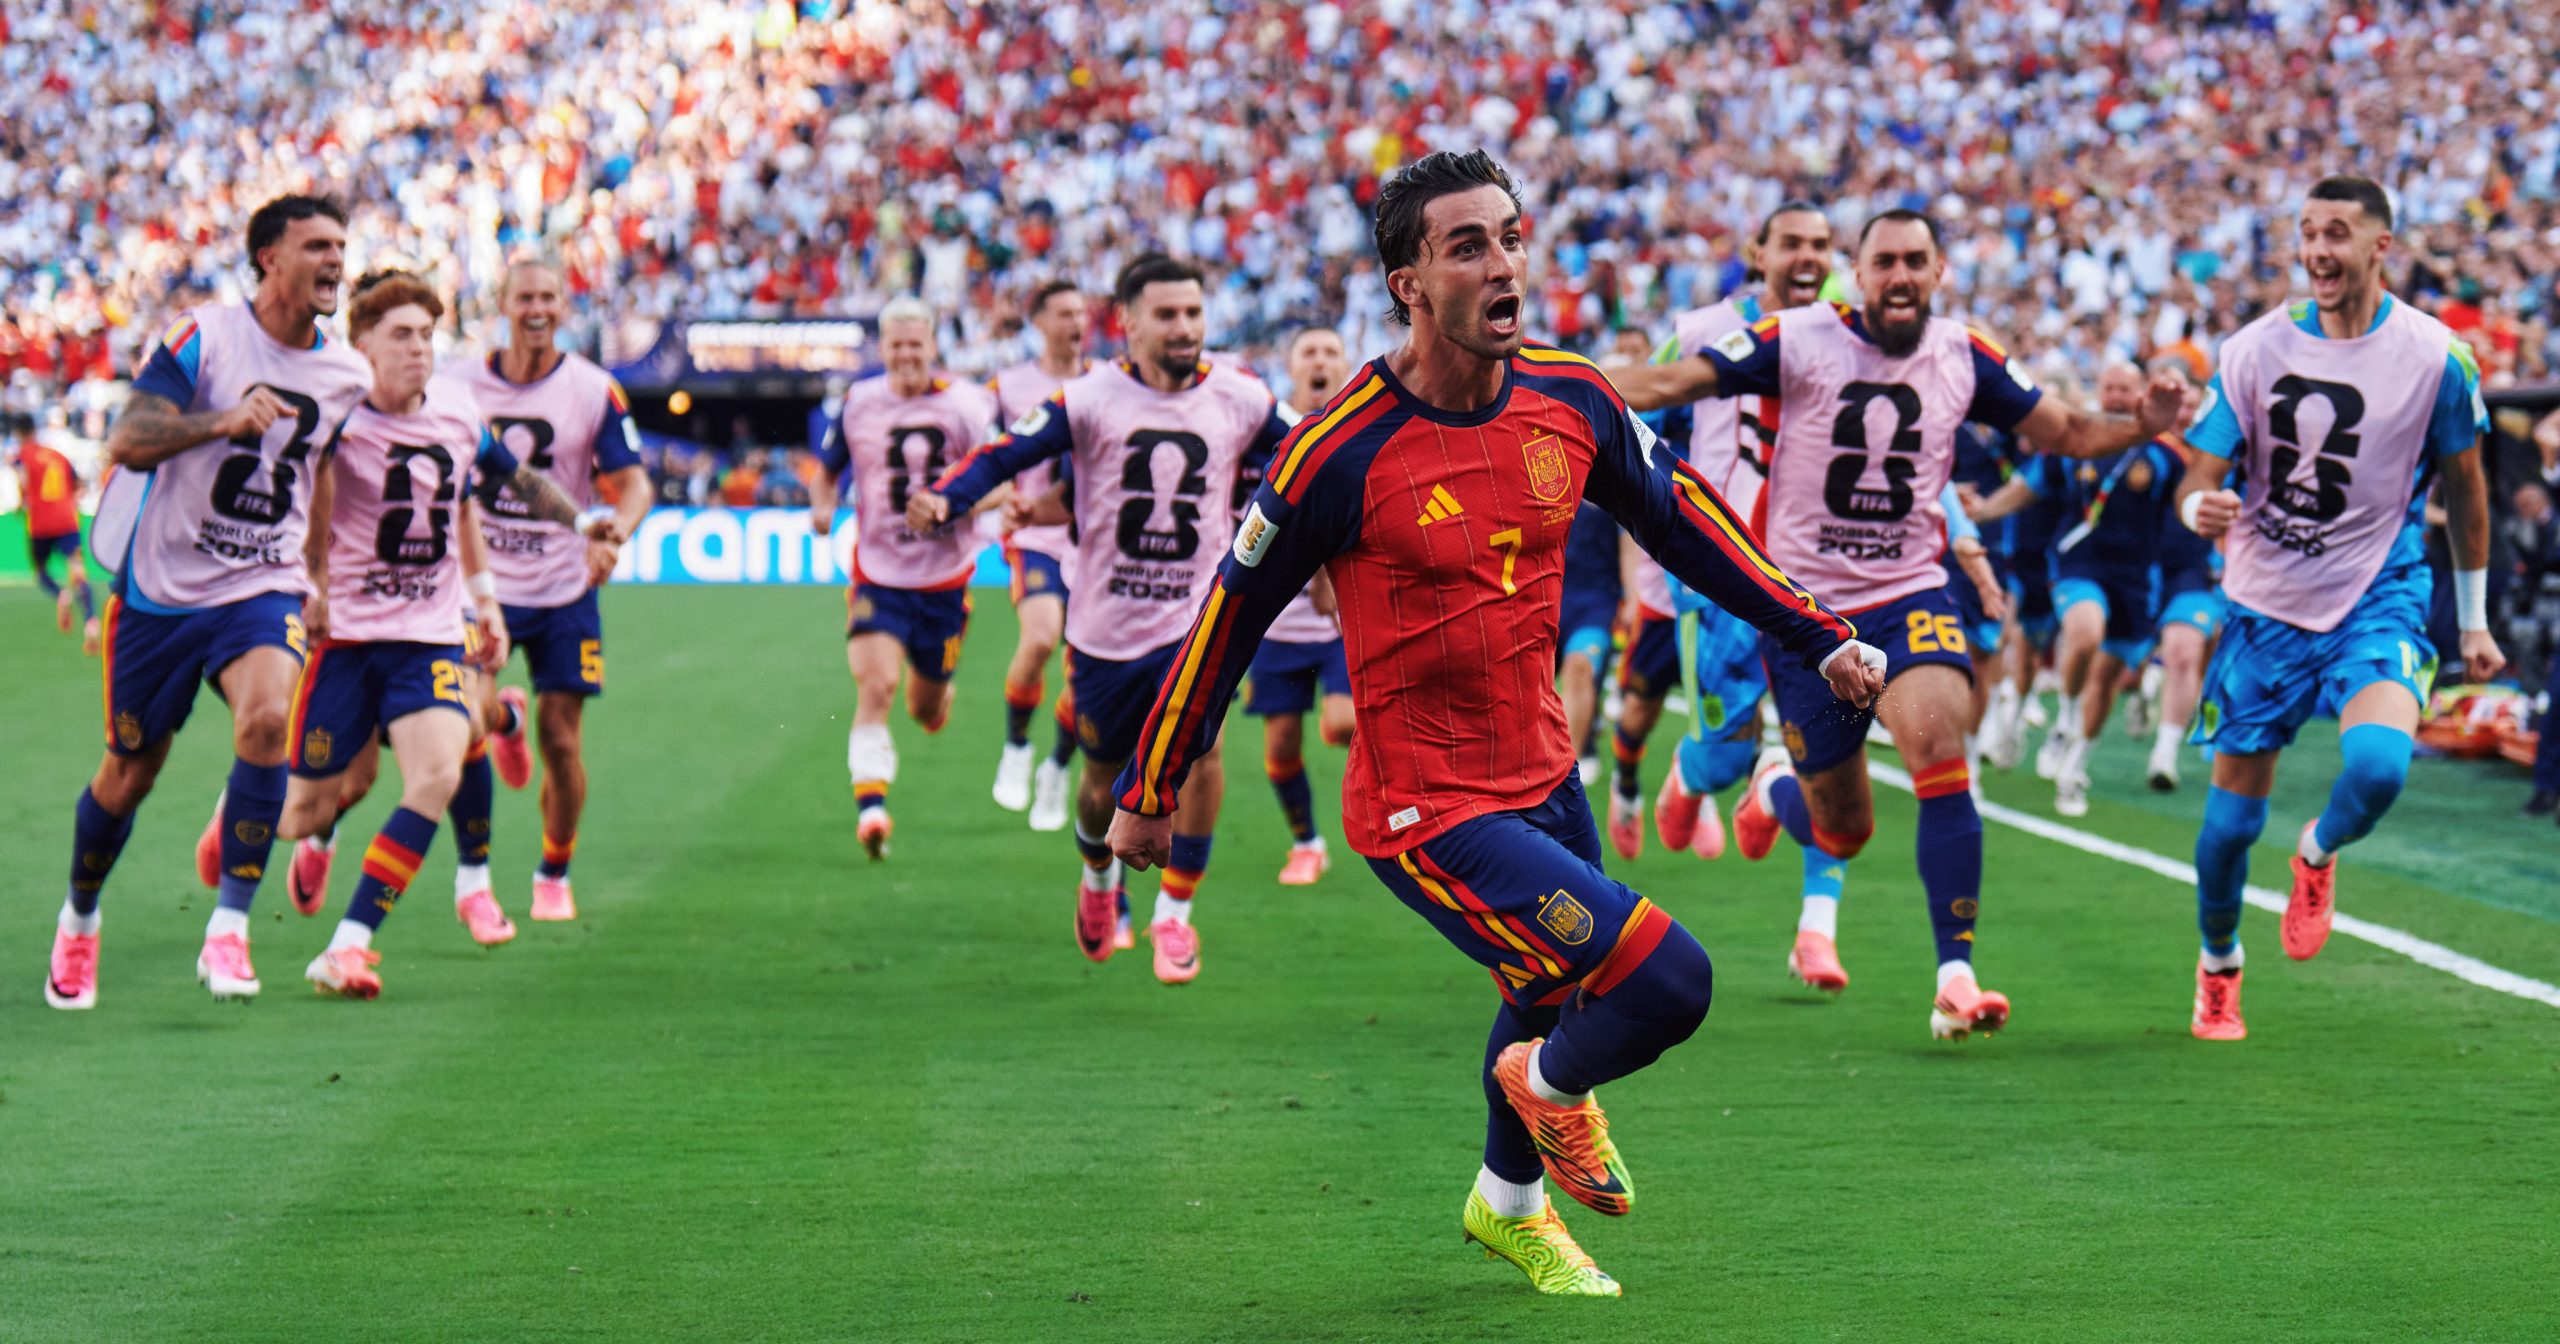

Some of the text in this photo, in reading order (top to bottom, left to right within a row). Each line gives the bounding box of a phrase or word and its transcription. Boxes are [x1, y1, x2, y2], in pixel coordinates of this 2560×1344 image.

[234, 492, 273, 516] FIFA
[1850, 493, 1893, 512] FIFA
[1138, 535, 1178, 553] FIFA
[1816, 537, 1903, 561] 2026
[1112, 562, 1195, 580] WORLD CUP
[1489, 527, 1522, 597] 7
[1107, 577, 1191, 601] 2026
[1906, 610, 1967, 655] 26
